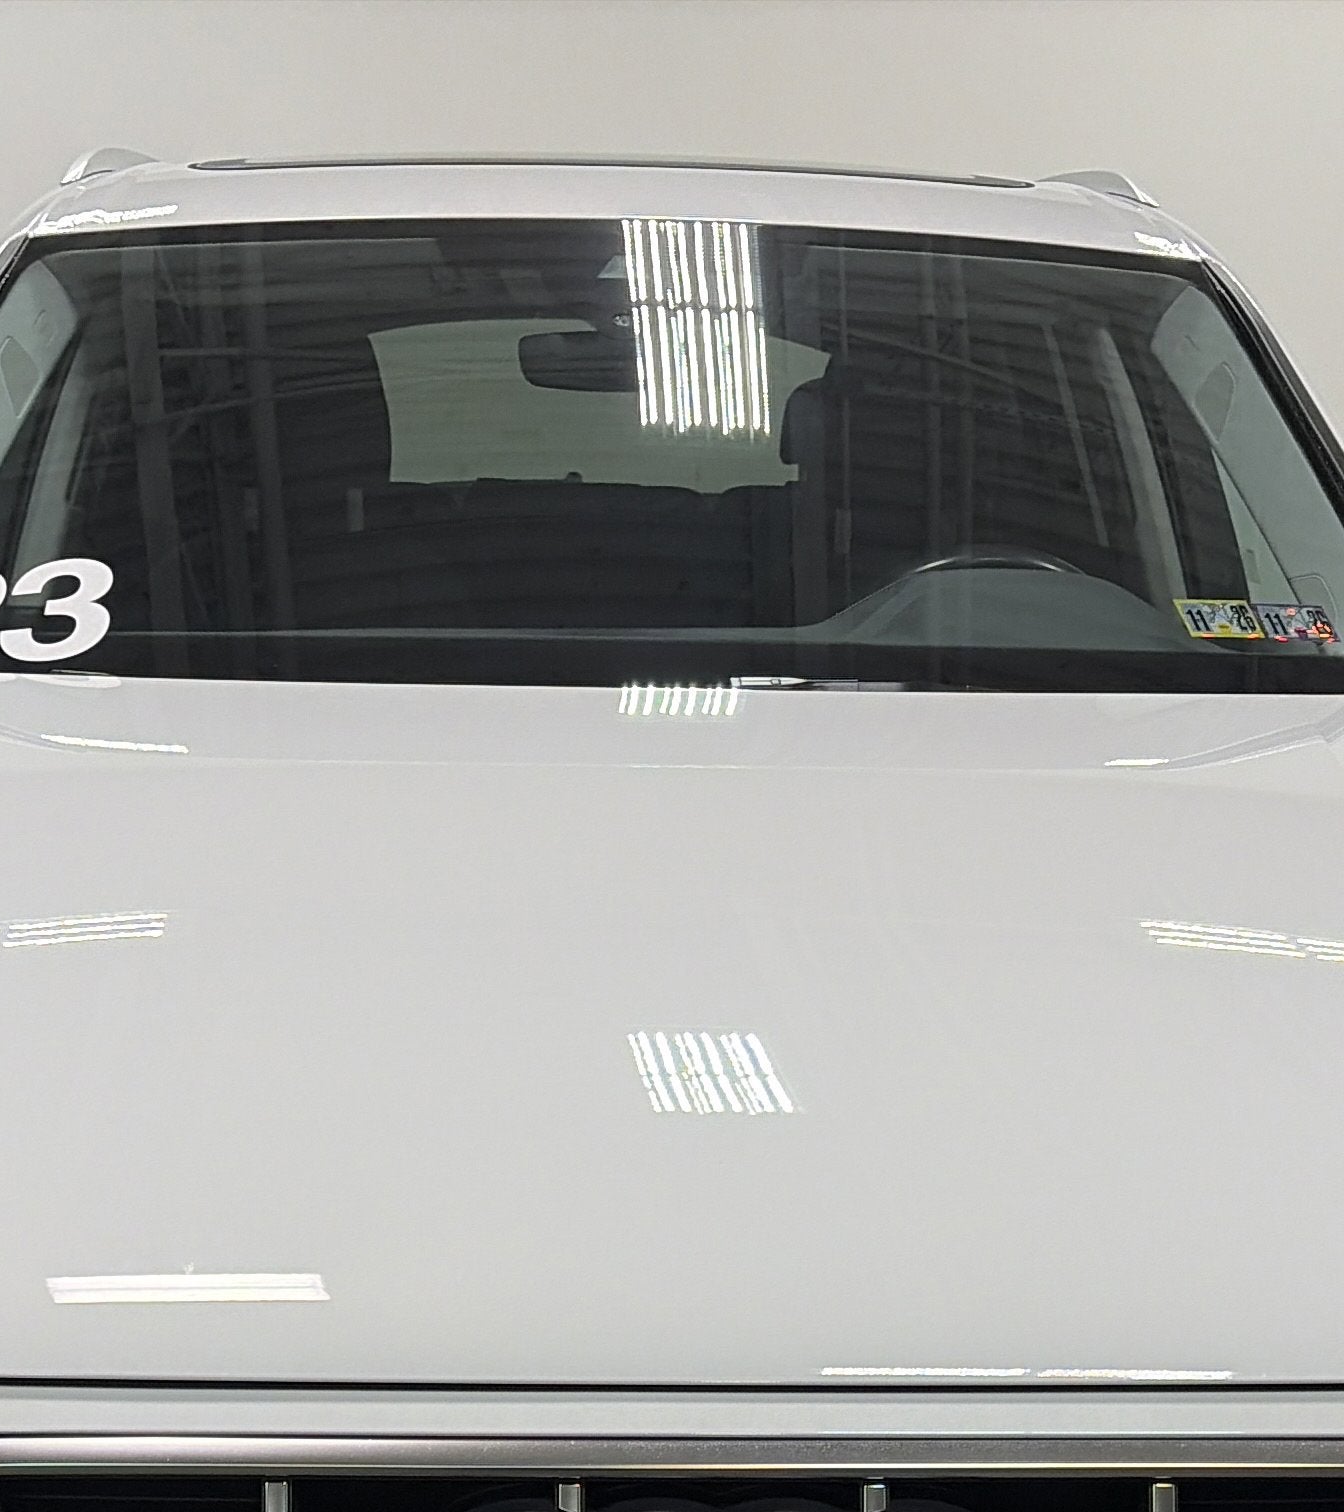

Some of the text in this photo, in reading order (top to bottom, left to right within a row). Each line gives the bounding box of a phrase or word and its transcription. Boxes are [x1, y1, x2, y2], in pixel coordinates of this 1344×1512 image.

[1186, 605, 1257, 632] 11 26
[1264, 612, 1289, 635] 11
